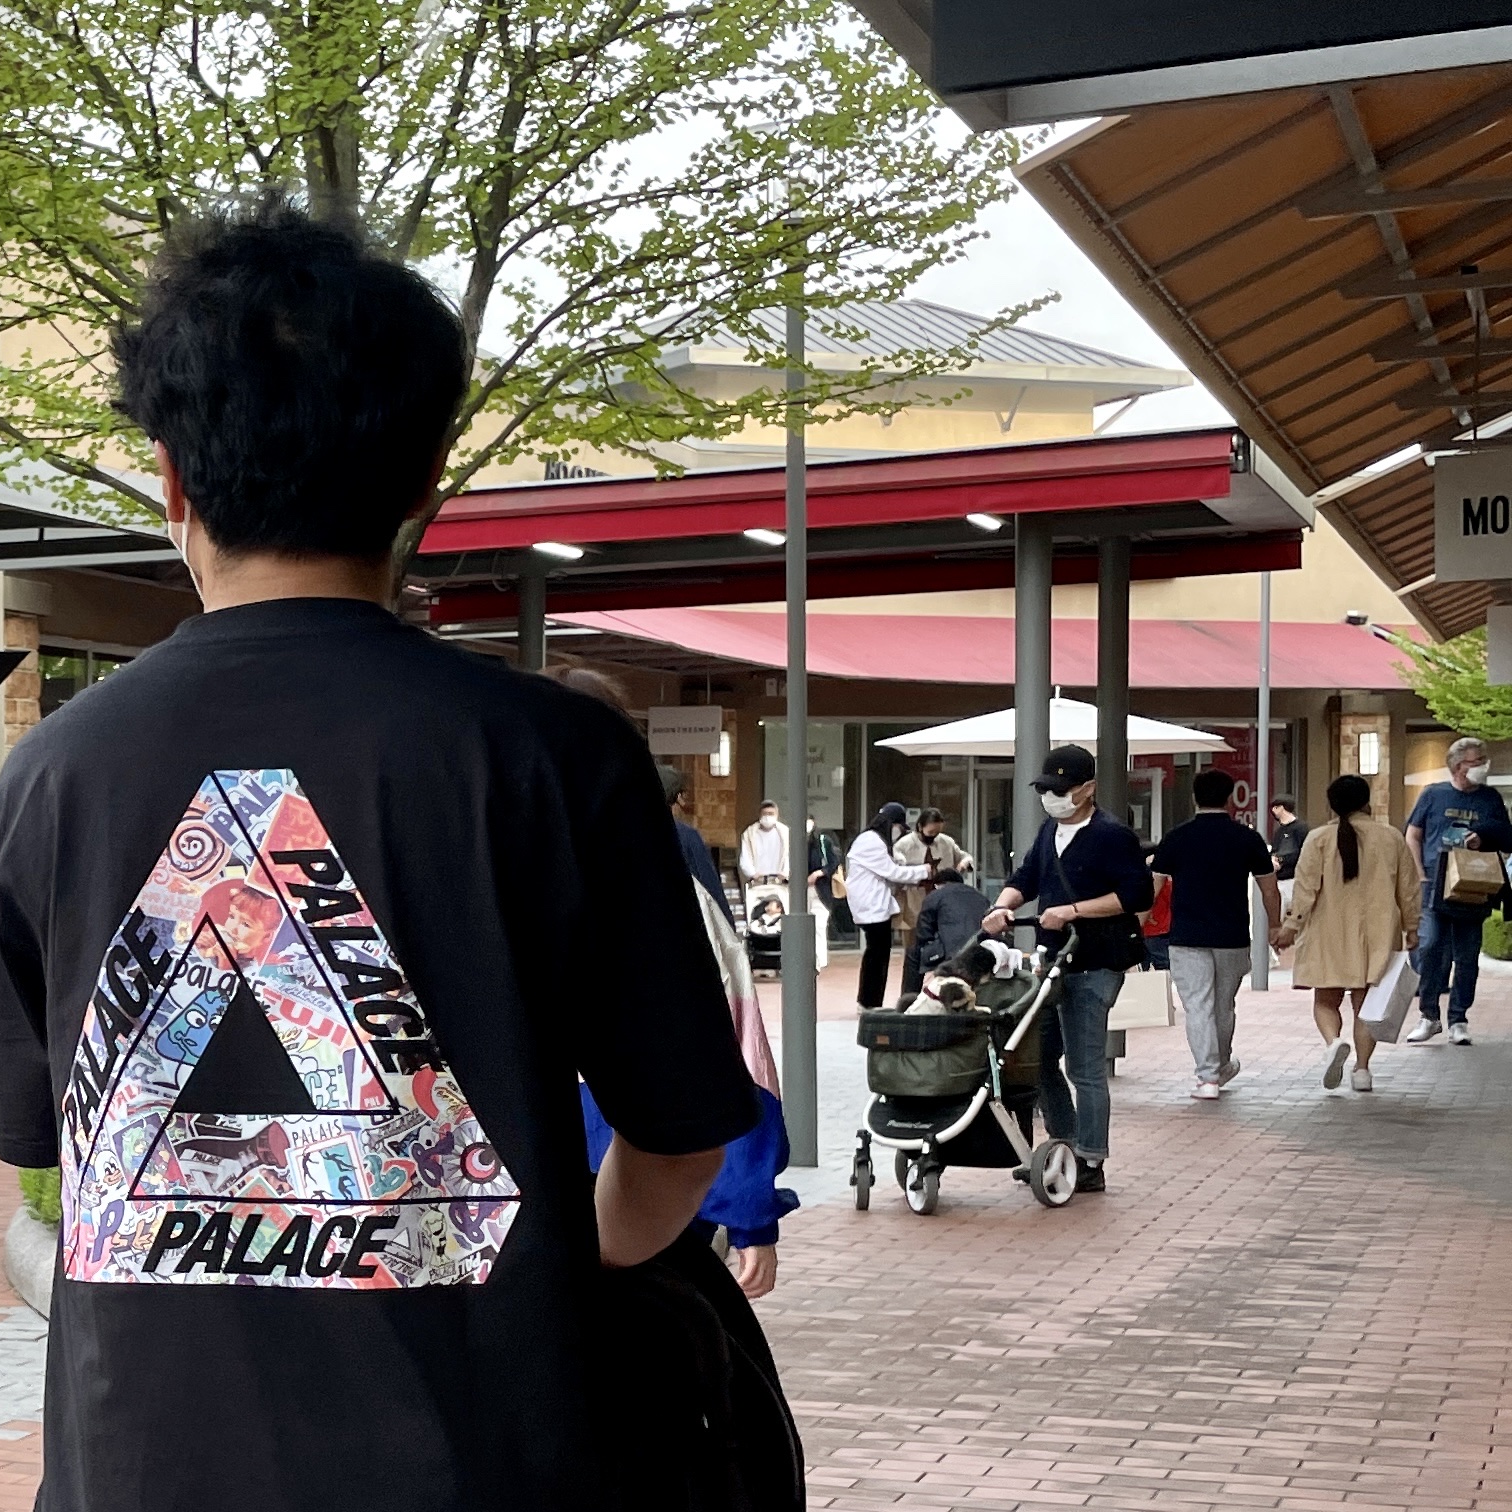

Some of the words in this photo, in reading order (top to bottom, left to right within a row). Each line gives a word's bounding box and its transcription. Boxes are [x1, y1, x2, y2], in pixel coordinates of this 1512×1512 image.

[1463, 496, 1510, 536] MO
[269, 849, 446, 1076] PALACE
[63, 905, 172, 1168] PALACE
[142, 1211, 399, 1278] PALACE
